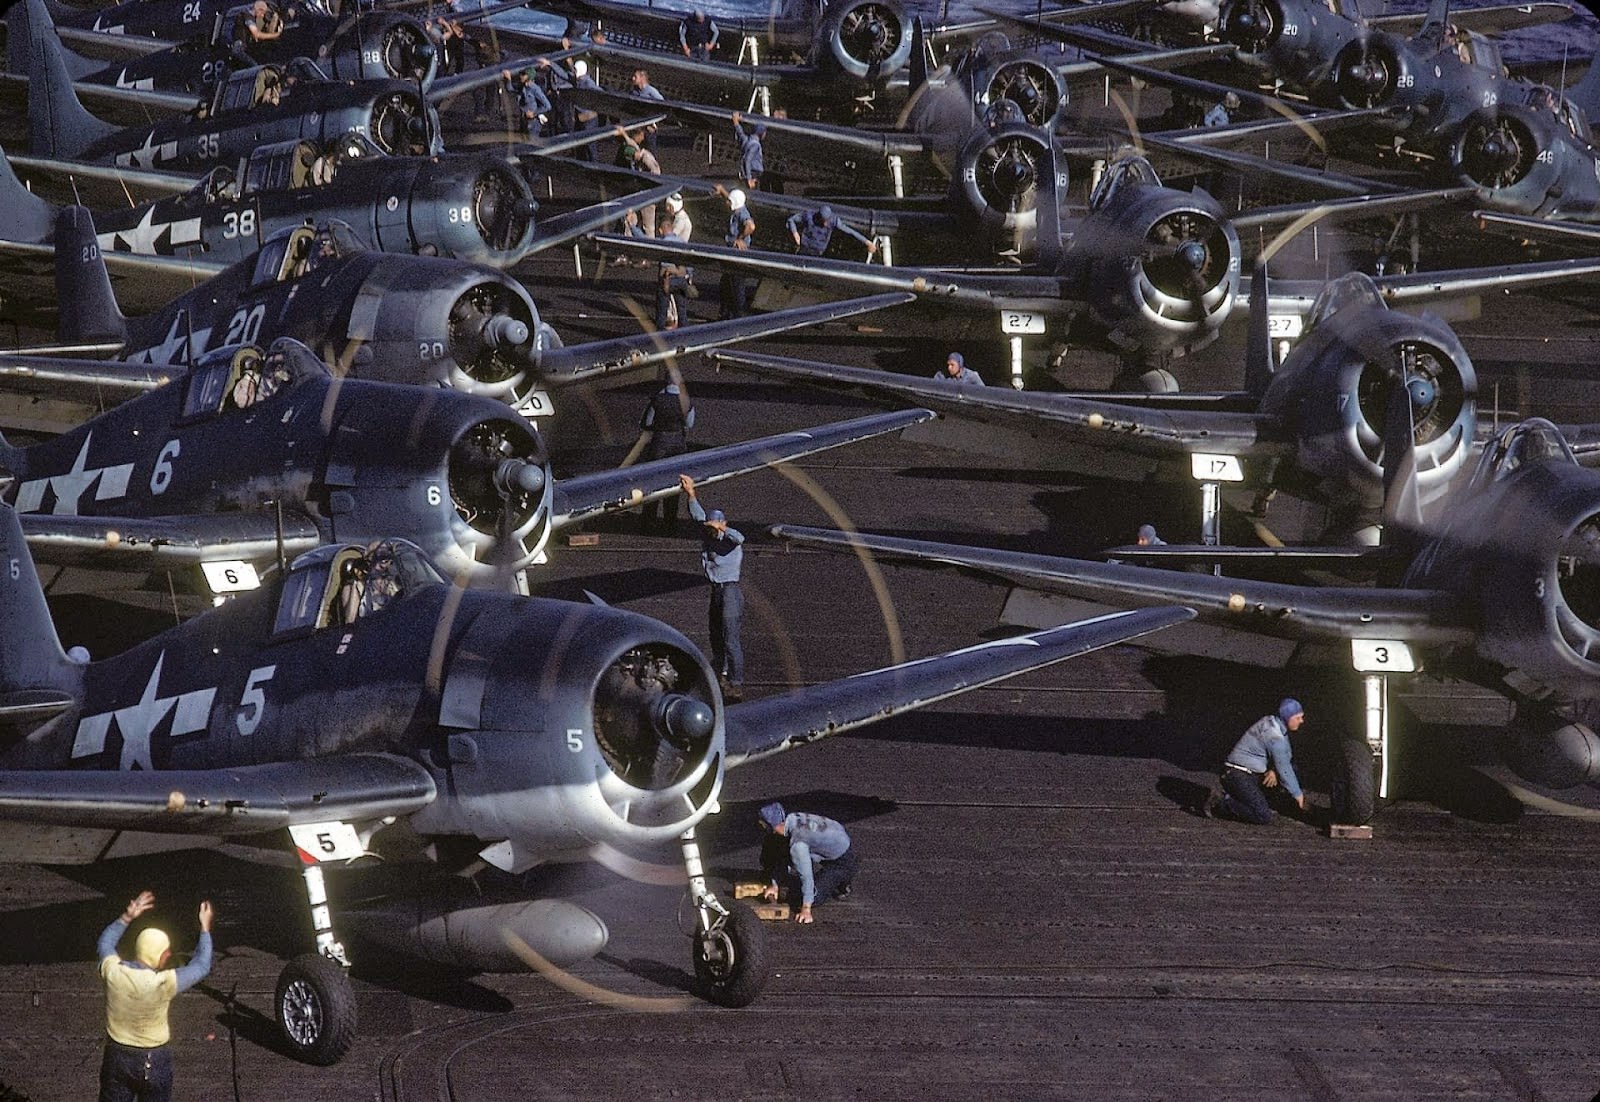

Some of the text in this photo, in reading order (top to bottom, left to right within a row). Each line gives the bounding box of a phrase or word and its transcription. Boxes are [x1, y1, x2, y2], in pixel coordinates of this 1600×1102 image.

[183, 1, 200, 23] 24
[364, 50, 380, 64] 28
[198, 133, 219, 159] 35
[223, 209, 256, 240] 38
[449, 206, 472, 223] 38
[81, 245, 97, 262] 20
[224, 304, 266, 347] 20
[1010, 315, 1032, 327] 27
[1269, 319, 1291, 331] 27
[420, 342, 443, 359] 20
[520, 397, 542, 410] 0
[151, 439, 180, 495] 6
[1211, 460, 1226, 473] 17
[427, 485, 441, 505] 6
[10, 559, 20, 580] 5
[225, 569, 238, 584] 6
[1535, 577, 1545, 597] 3
[1375, 647, 1389, 664] 3
[236, 664, 277, 737] 5
[566, 728, 583, 753] 5
[317, 832, 335, 853] 5
